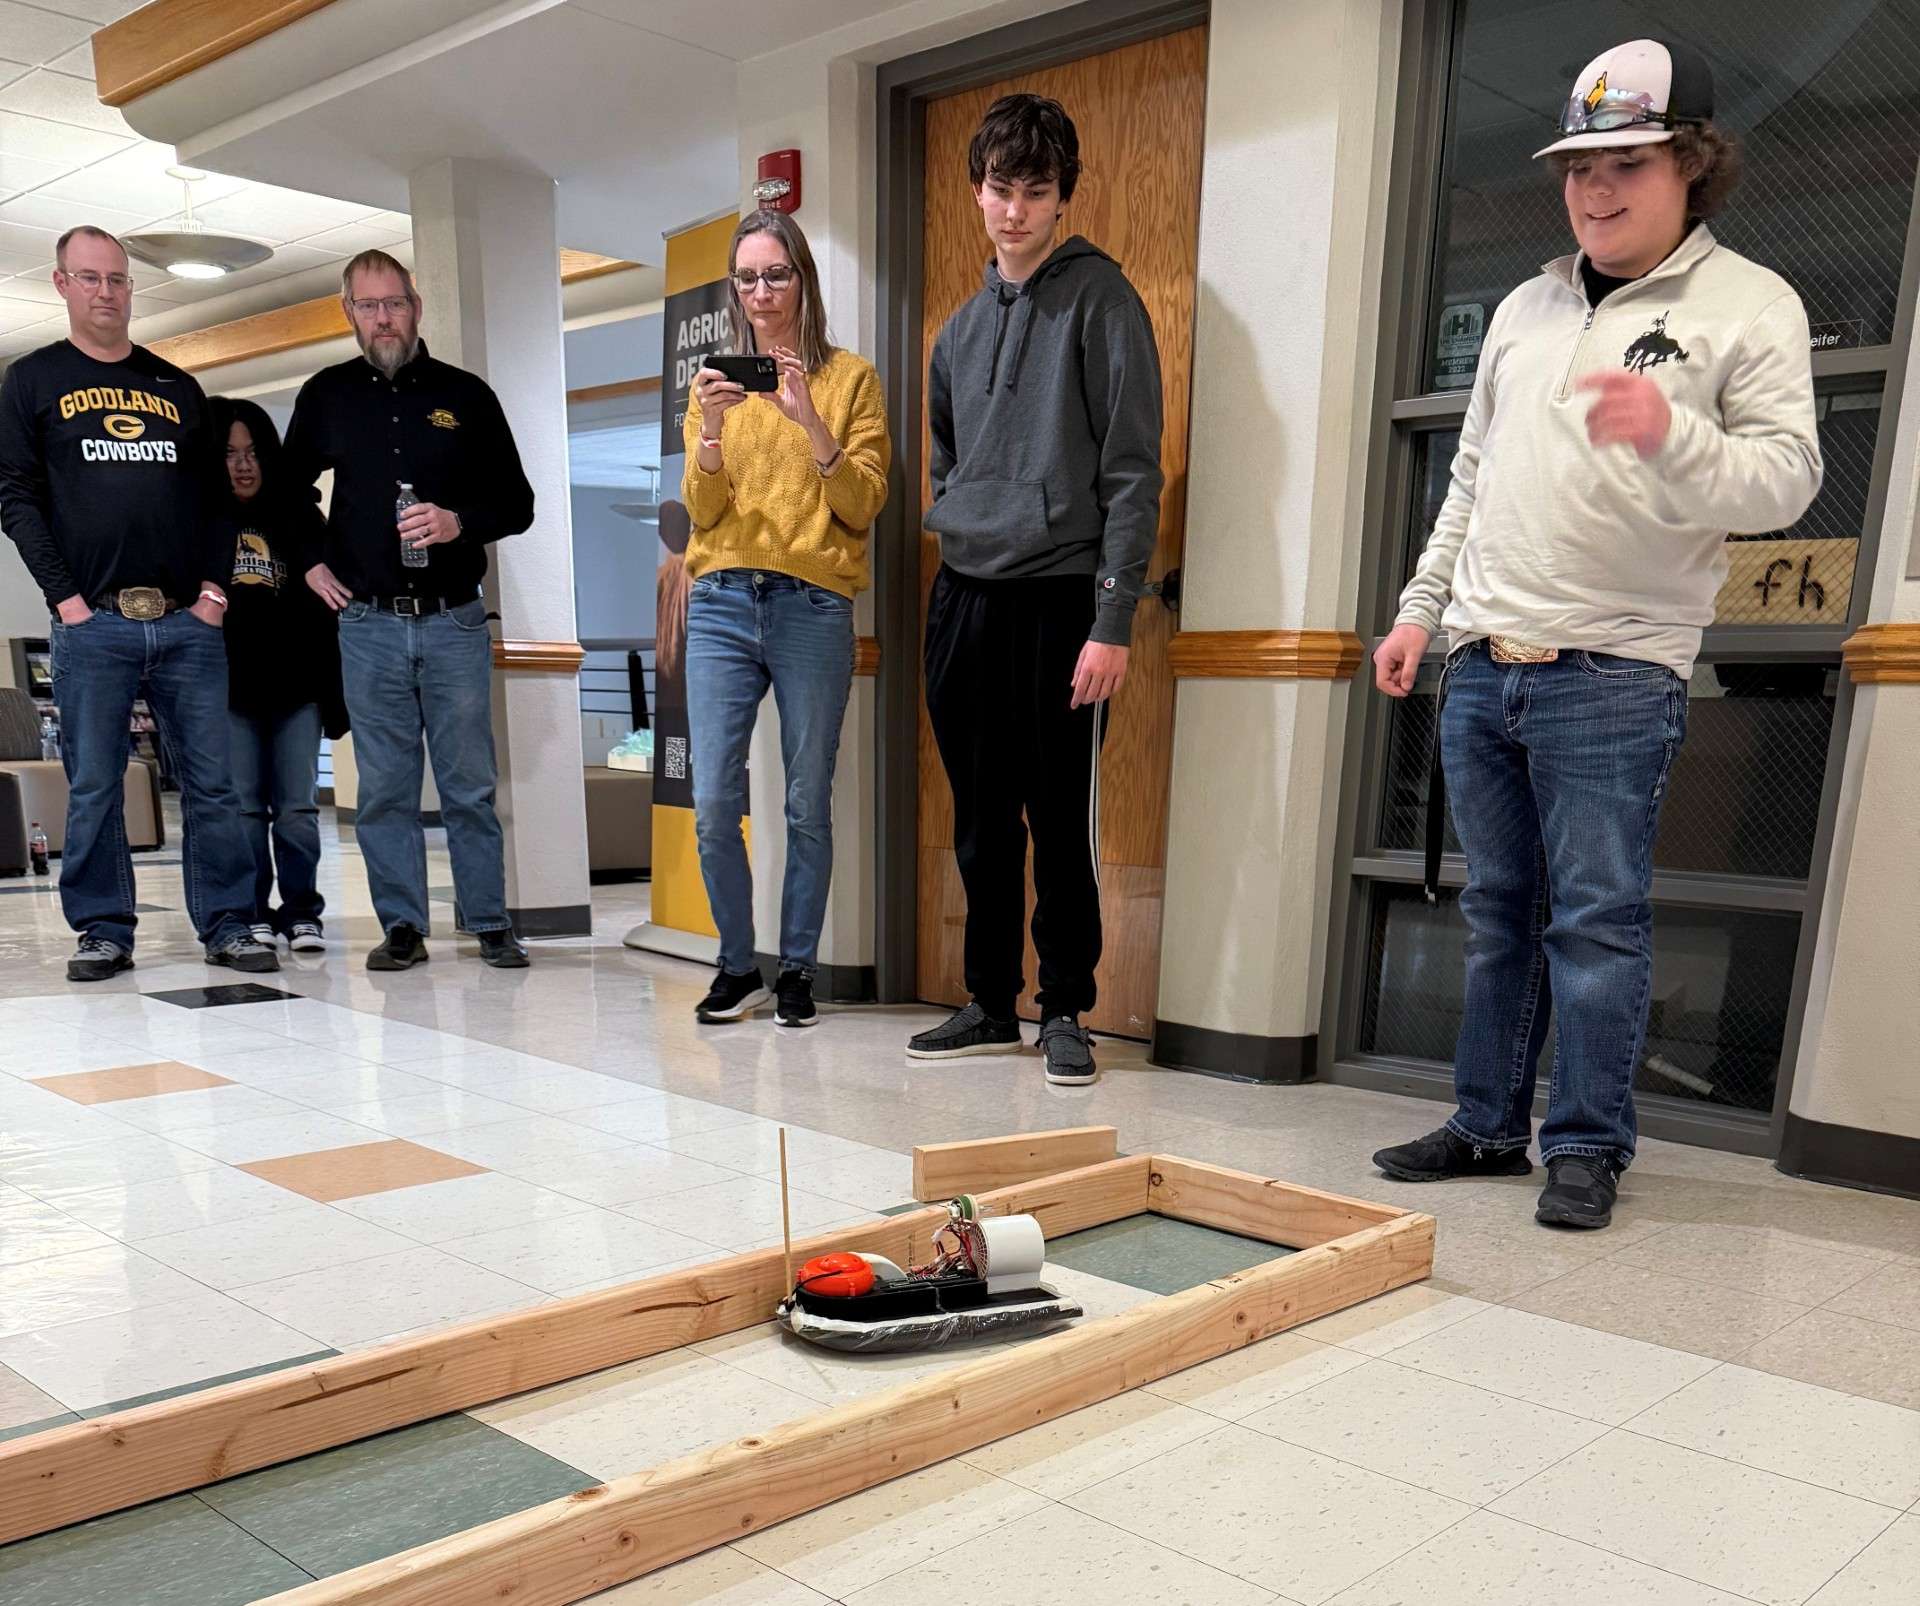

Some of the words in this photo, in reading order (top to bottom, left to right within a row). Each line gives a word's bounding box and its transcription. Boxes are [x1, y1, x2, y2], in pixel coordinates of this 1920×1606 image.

[677, 308, 729, 351] AGRIC
[1810, 333, 1841, 347] eifer
[59, 387, 181, 425] GOODLAND
[103, 414, 146, 440] G
[81, 439, 177, 463] COWBOYS
